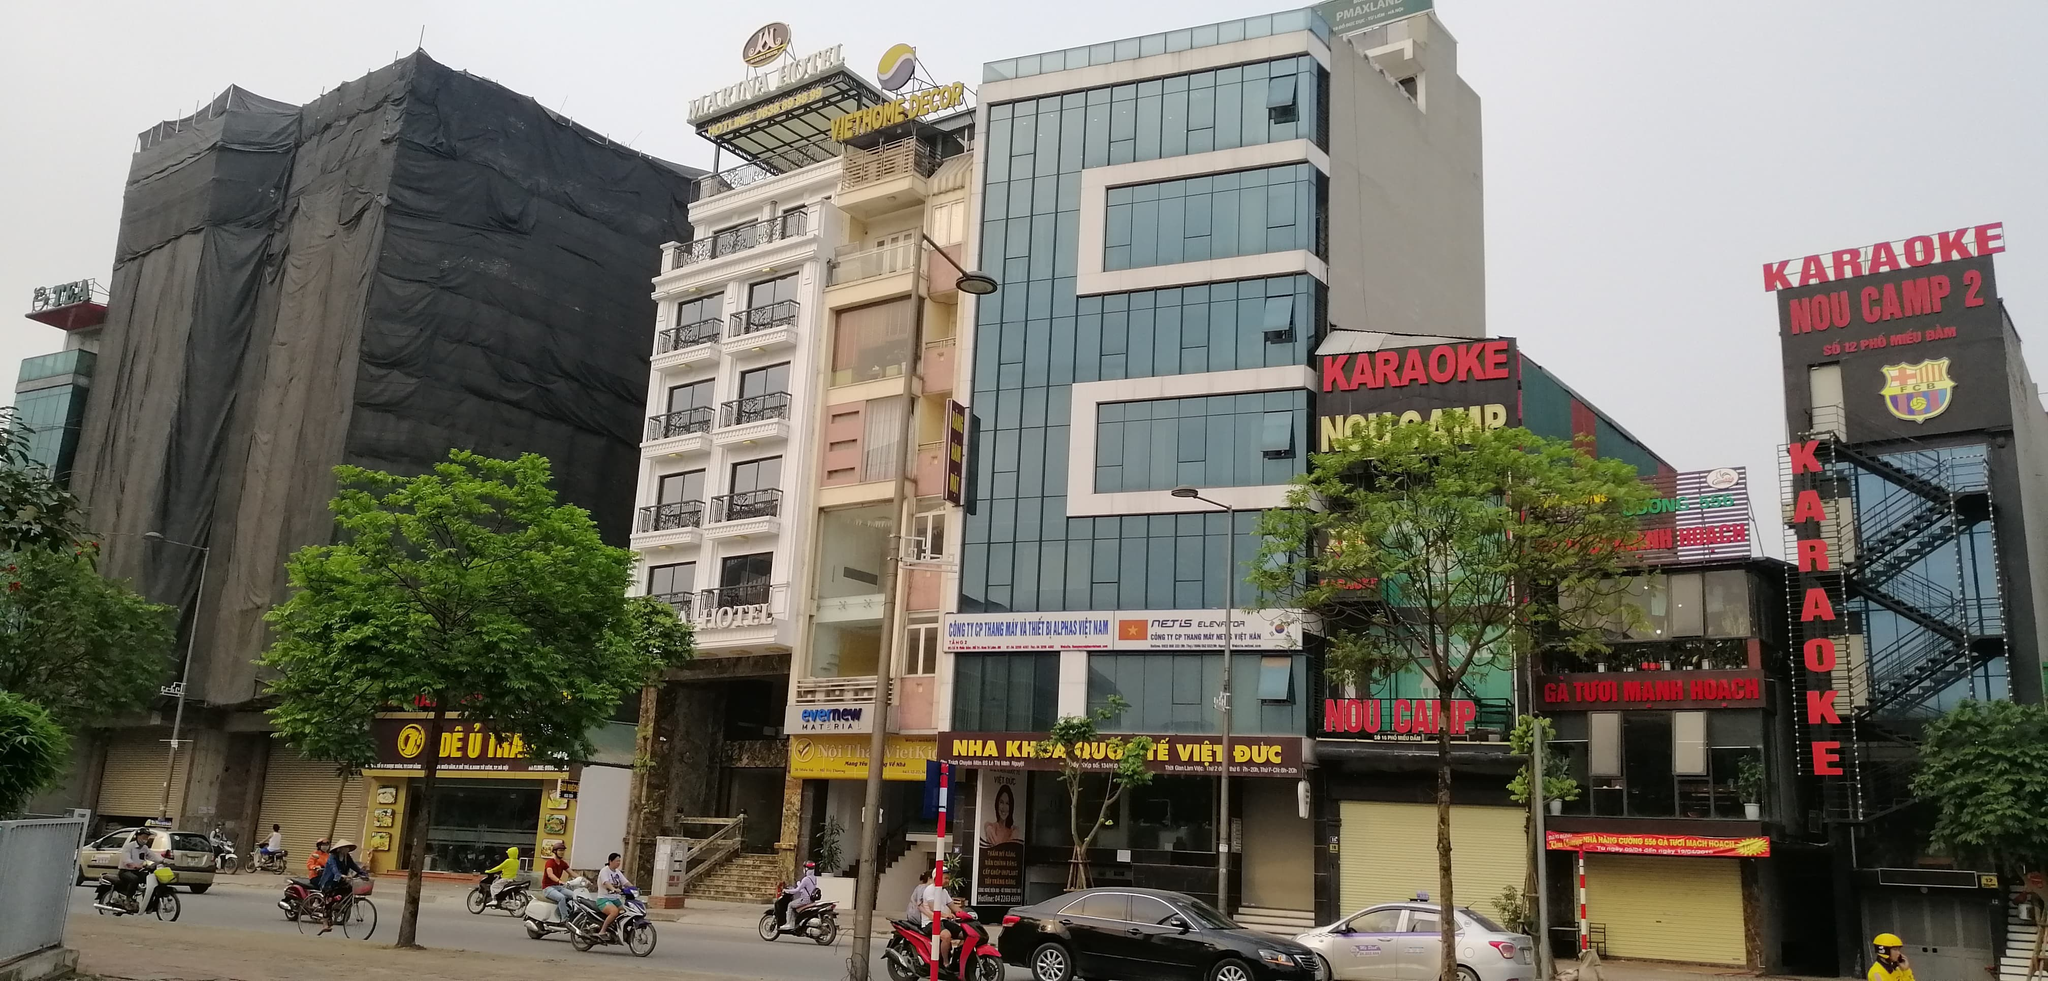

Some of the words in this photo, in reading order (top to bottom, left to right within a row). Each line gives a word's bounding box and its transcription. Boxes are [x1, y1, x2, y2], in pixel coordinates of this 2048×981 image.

[687, 71, 770, 121] MARINA
[776, 43, 845, 88] HOTEL
[831, 98, 906, 140] VIETHOME
[907, 81, 964, 120] DECOR
[1762, 221, 2006, 292] KARAOKE
[52, 279, 91, 307] TEA
[1789, 290, 1851, 335] NOU
[1861, 274, 1951, 323] CAMP
[1962, 269, 1985, 308] 2
[1844, 341, 1858, 353] 12
[1322, 340, 1510, 393] KARAOKE
[1699, 493, 1735, 509] 556
[700, 602, 774, 630] HOTEL
[1788, 439, 1844, 776] KARAOKE
[948, 620, 966, 638] CÔNG
[966, 622, 974, 637] TY
[974, 622, 983, 637] CP
[984, 622, 1005, 637] THANG
[1005, 618, 1019, 637] MÁY
[1019, 617, 1027, 637] VÀ
[1027, 615, 1045, 637] THIẾT
[1053, 619, 1077, 636] ALPHAS
[1078, 617, 1092, 638] VIỆT
[1093, 619, 1109, 636] NAM
[1150, 632, 1165, 640] CÔNG
[1544, 676, 1570, 703] GÀ
[1573, 680, 1618, 703] TƯƠI
[1623, 679, 1684, 709] MẠNH
[1690, 678, 1760, 708] HOẠCH
[801, 708, 863, 722] evernew
[1325, 698, 1381, 733] NOU
[1393, 698, 1476, 735] CAMP
[438, 725, 464, 758] DÊ
[467, 722, 483, 759] Ủ
[817, 743, 842, 761] Nội
[952, 739, 999, 757] NHA
[1175, 740, 1223, 767] VIỆT
[1233, 741, 1282, 764] ĐỨC
